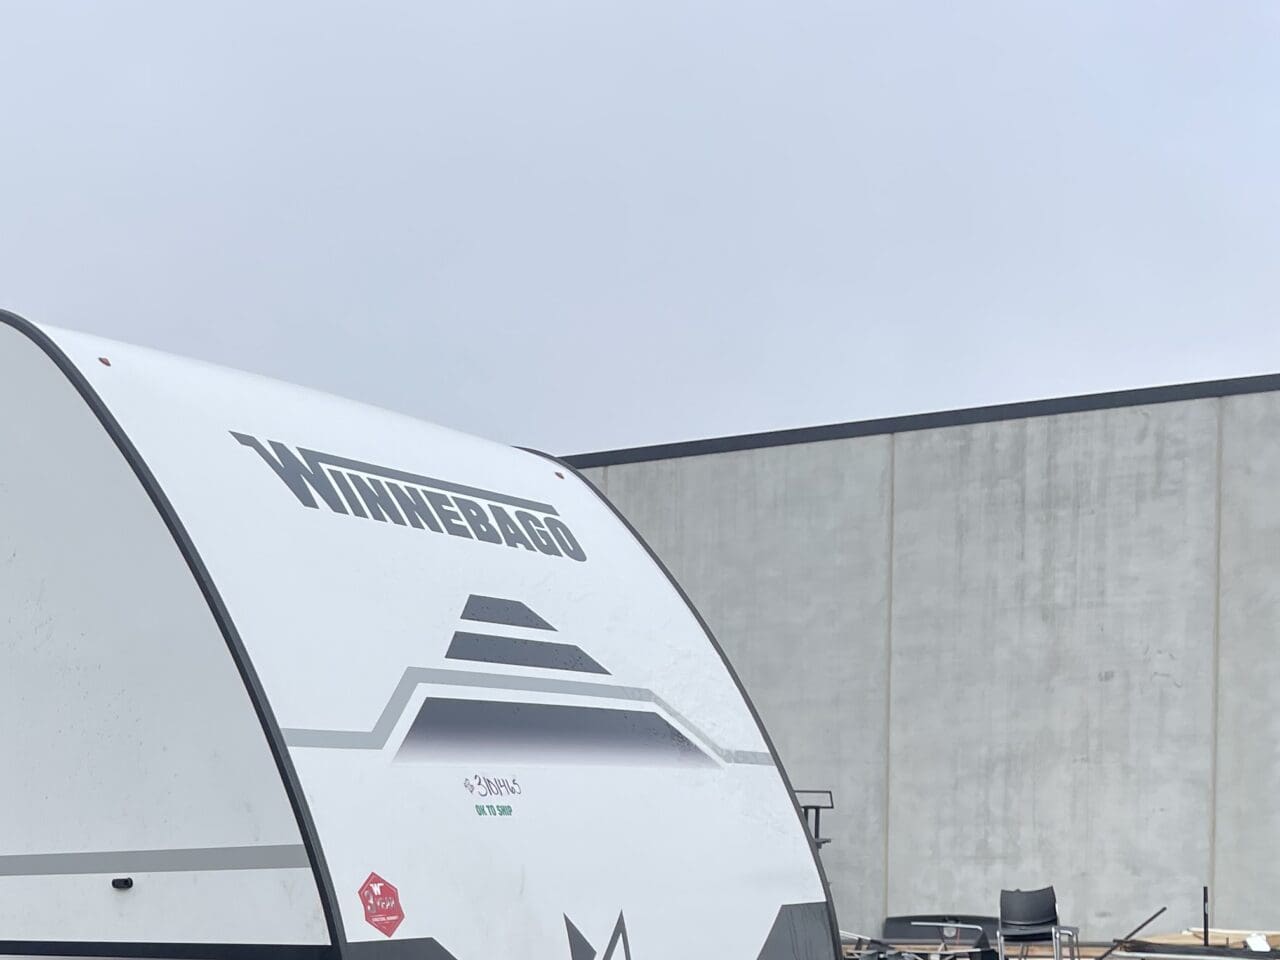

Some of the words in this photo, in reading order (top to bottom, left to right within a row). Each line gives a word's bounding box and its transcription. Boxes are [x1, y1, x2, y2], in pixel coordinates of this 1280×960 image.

[228, 430, 588, 562] WINNEBAGO
[475, 804, 486, 816] OK
[486, 805, 497, 816] TO
[496, 805, 513, 817] SHIP
